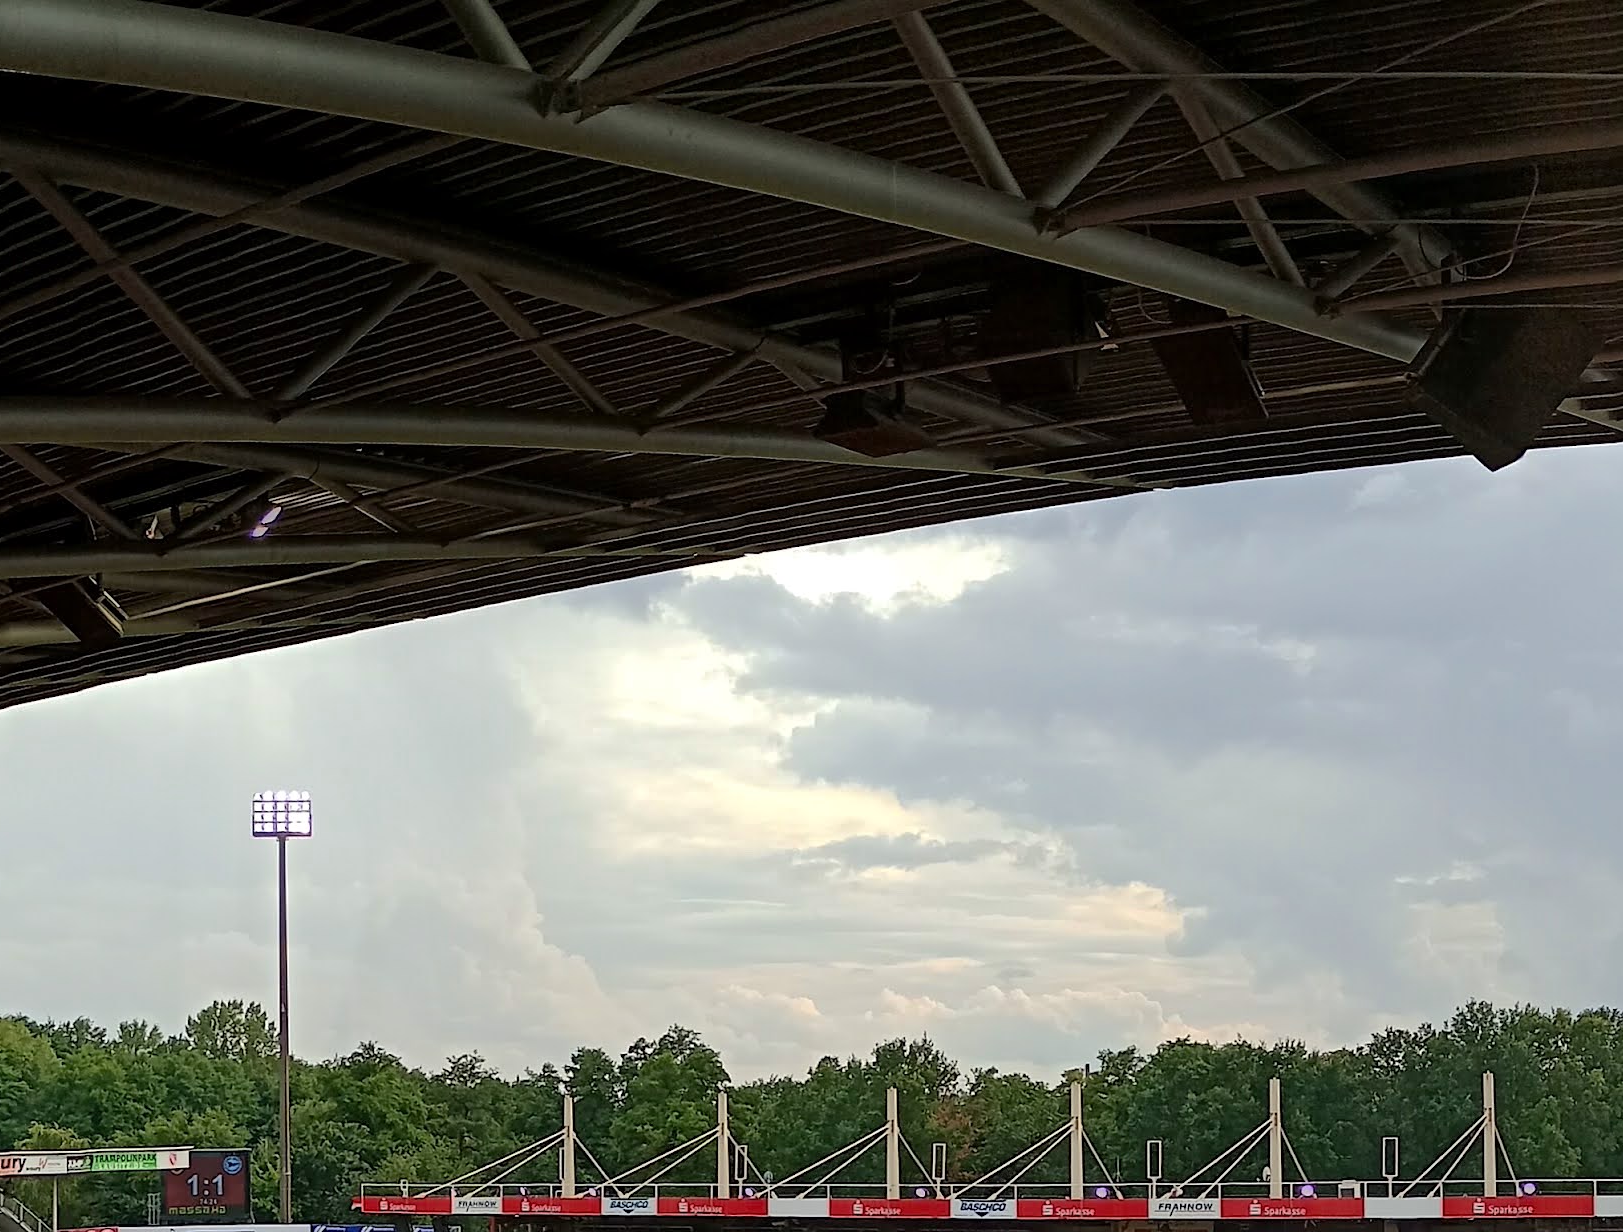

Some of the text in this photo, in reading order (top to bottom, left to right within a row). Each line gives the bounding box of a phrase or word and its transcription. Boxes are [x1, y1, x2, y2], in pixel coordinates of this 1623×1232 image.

[187, 1174, 225, 1196] 1:1
[389, 1203, 417, 1212] Sparkasse
[531, 1204, 562, 1213] Sparkasse
[610, 1200, 649, 1209] BASCHCO
[690, 1204, 723, 1214] Sparkasse
[960, 1201, 1007, 1212] BASCHCO
[1158, 1202, 1214, 1216] FRAHNOW
[1487, 1204, 1534, 1216] Sparkasse
[864, 1206, 902, 1216] Sparkasse
[1055, 1206, 1096, 1217] Sparkasse
[1263, 1206, 1307, 1217] Sparkasse
